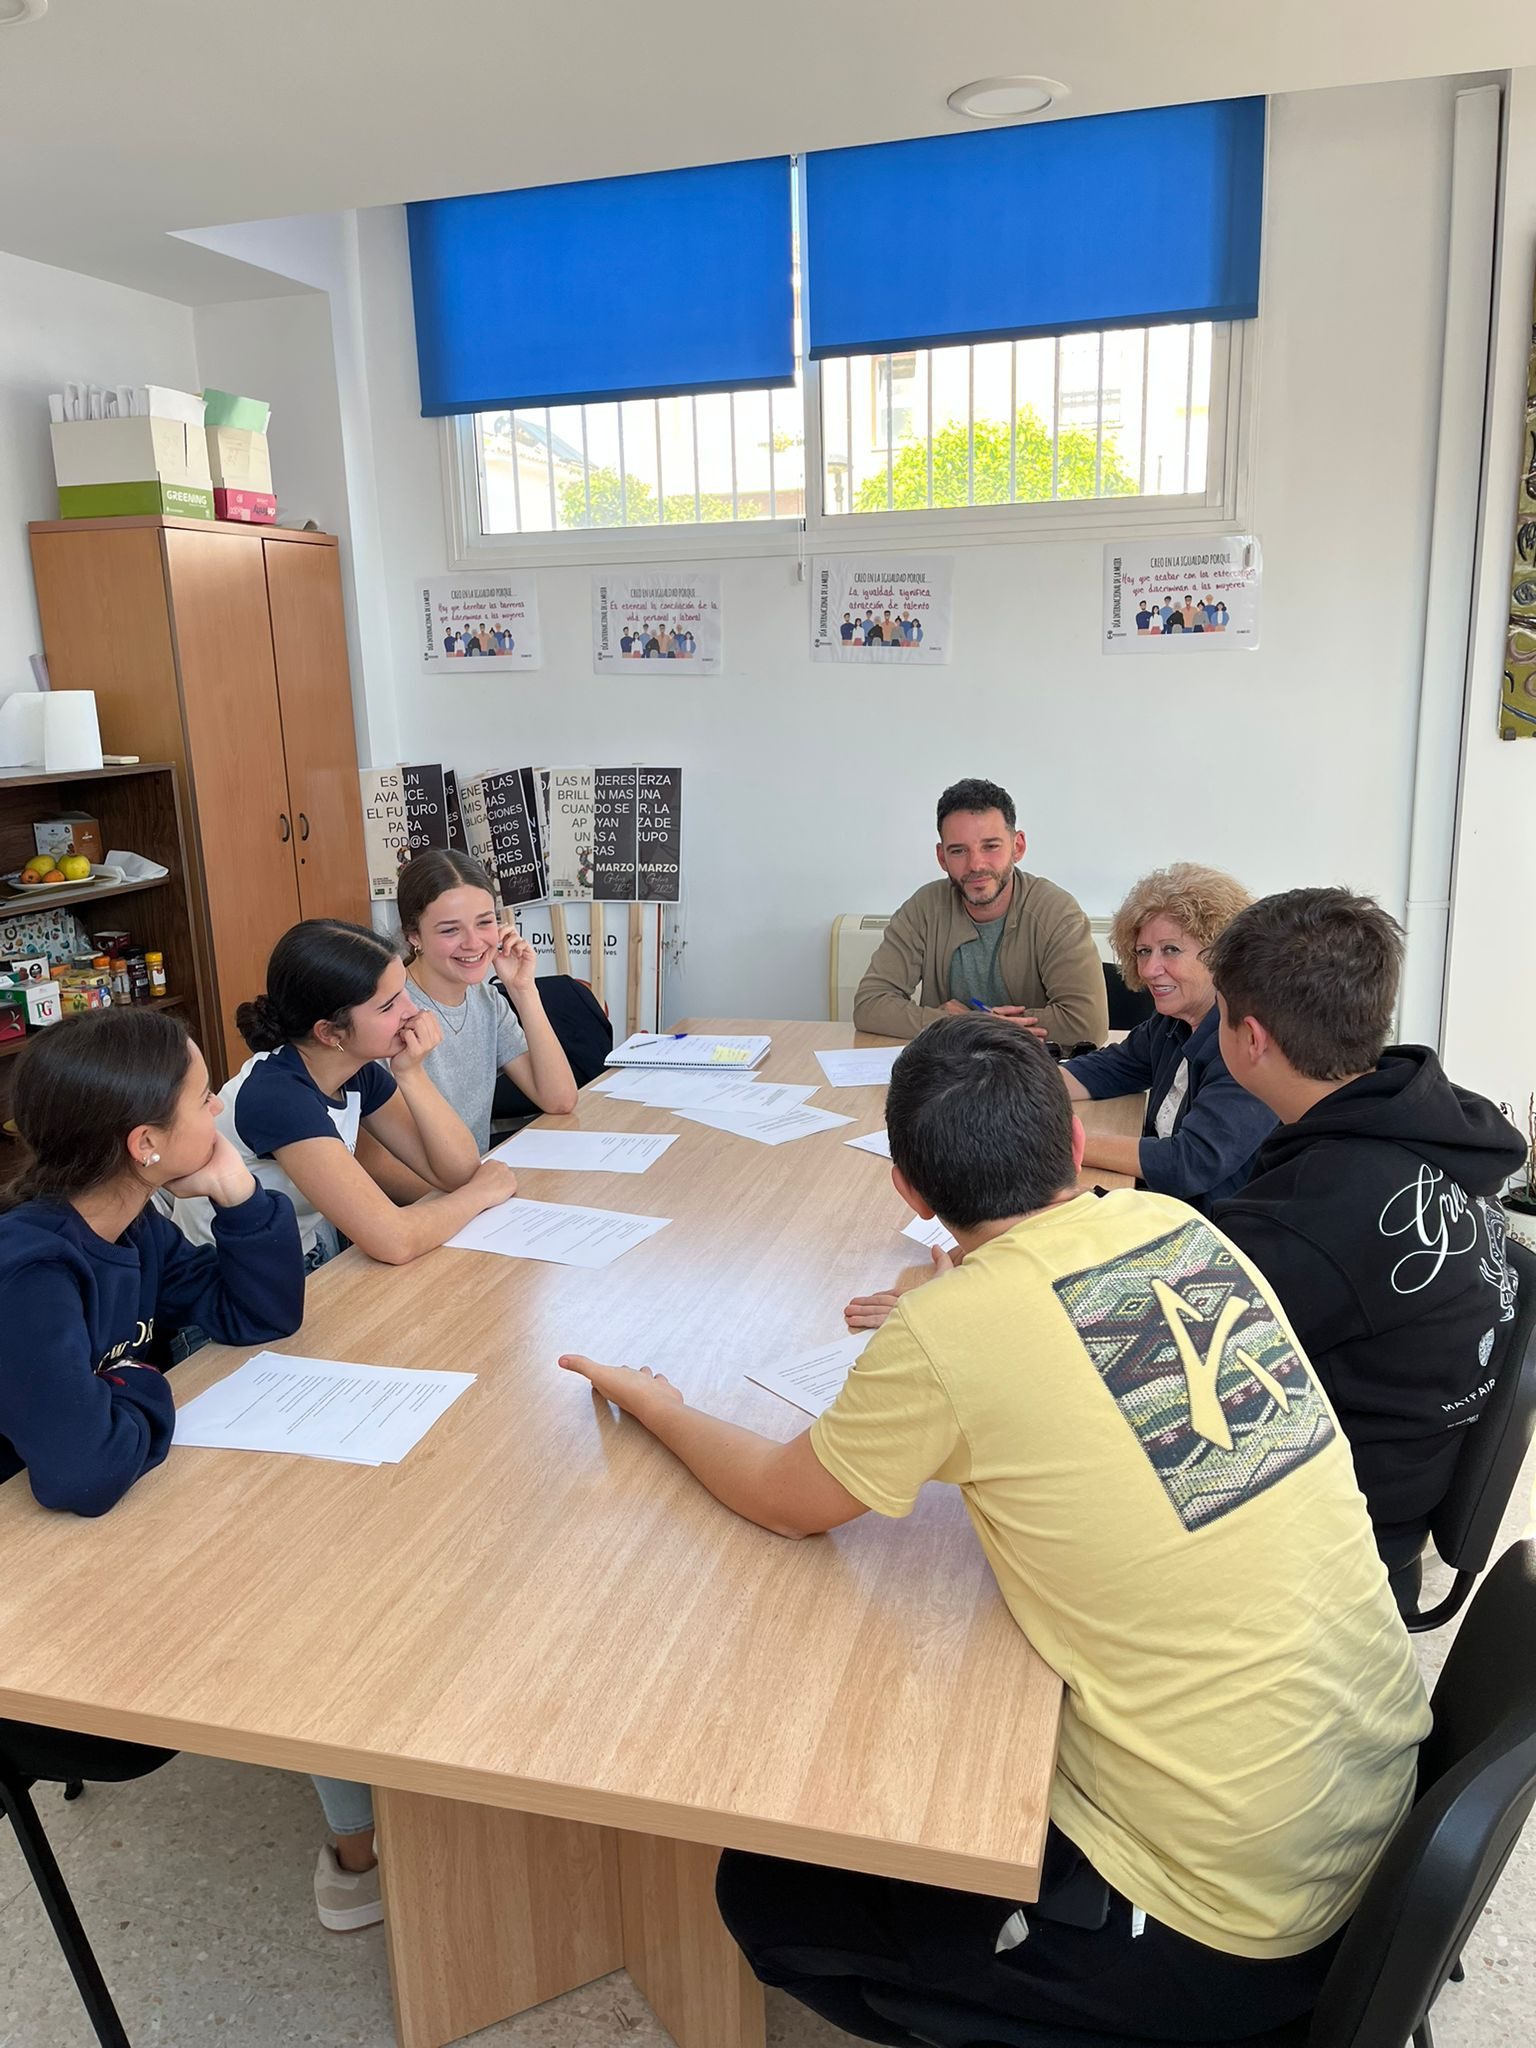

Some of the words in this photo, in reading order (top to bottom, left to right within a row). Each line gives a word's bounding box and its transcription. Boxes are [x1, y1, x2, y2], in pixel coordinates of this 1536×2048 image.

[166, 490, 207, 505] GREENING
[1150, 557, 1165, 568] CREO
[1165, 556, 1173, 567] EN
[1173, 556, 1180, 567] LA
[1180, 554, 1209, 566] IGUALDAD
[854, 572, 866, 583] CREO
[867, 572, 874, 583] EN
[874, 572, 880, 583] LA
[881, 572, 906, 583] IGUALDAD
[1121, 573, 1134, 585] Hay
[1139, 575, 1150, 584] que
[1155, 571, 1180, 581] acabar
[849, 587, 859, 596] La
[862, 585, 894, 601] igualdad
[899, 588, 931, 601] significa
[1133, 588, 1144, 597] que
[1148, 584, 1189, 593] discriminan
[1201, 582, 1211, 590] las
[849, 600, 884, 610] atracción
[888, 598, 898, 610] de
[903, 601, 930, 610] talento
[380, 775, 398, 788] ES
[491, 774, 515, 791] LAS
[555, 776, 578, 786] LAS
[581, 775, 636, 786] MUJERES
[609, 789, 634, 800] MAS
[367, 808, 383, 819] EL
[386, 803, 438, 818] FUTURO
[561, 803, 612, 814] CUANDO
[614, 803, 630, 814] SE
[654, 803, 670, 814] LA
[388, 820, 423, 833] PARA
[571, 817, 619, 828] APYAN
[654, 817, 672, 828] DE
[382, 834, 431, 849] TOD@S
[574, 831, 605, 842] UNAS
[607, 831, 617, 842] A
[471, 841, 493, 857] QUE
[495, 833, 520, 850] LOS
[575, 845, 615, 856] OTRAS
[499, 862, 535, 879] MARZO
[596, 863, 635, 872] MARZO
[638, 863, 678, 873] MARZO
[36, 1000, 52, 1018] PG
[1441, 1378, 1496, 1412] MAYFAIR
